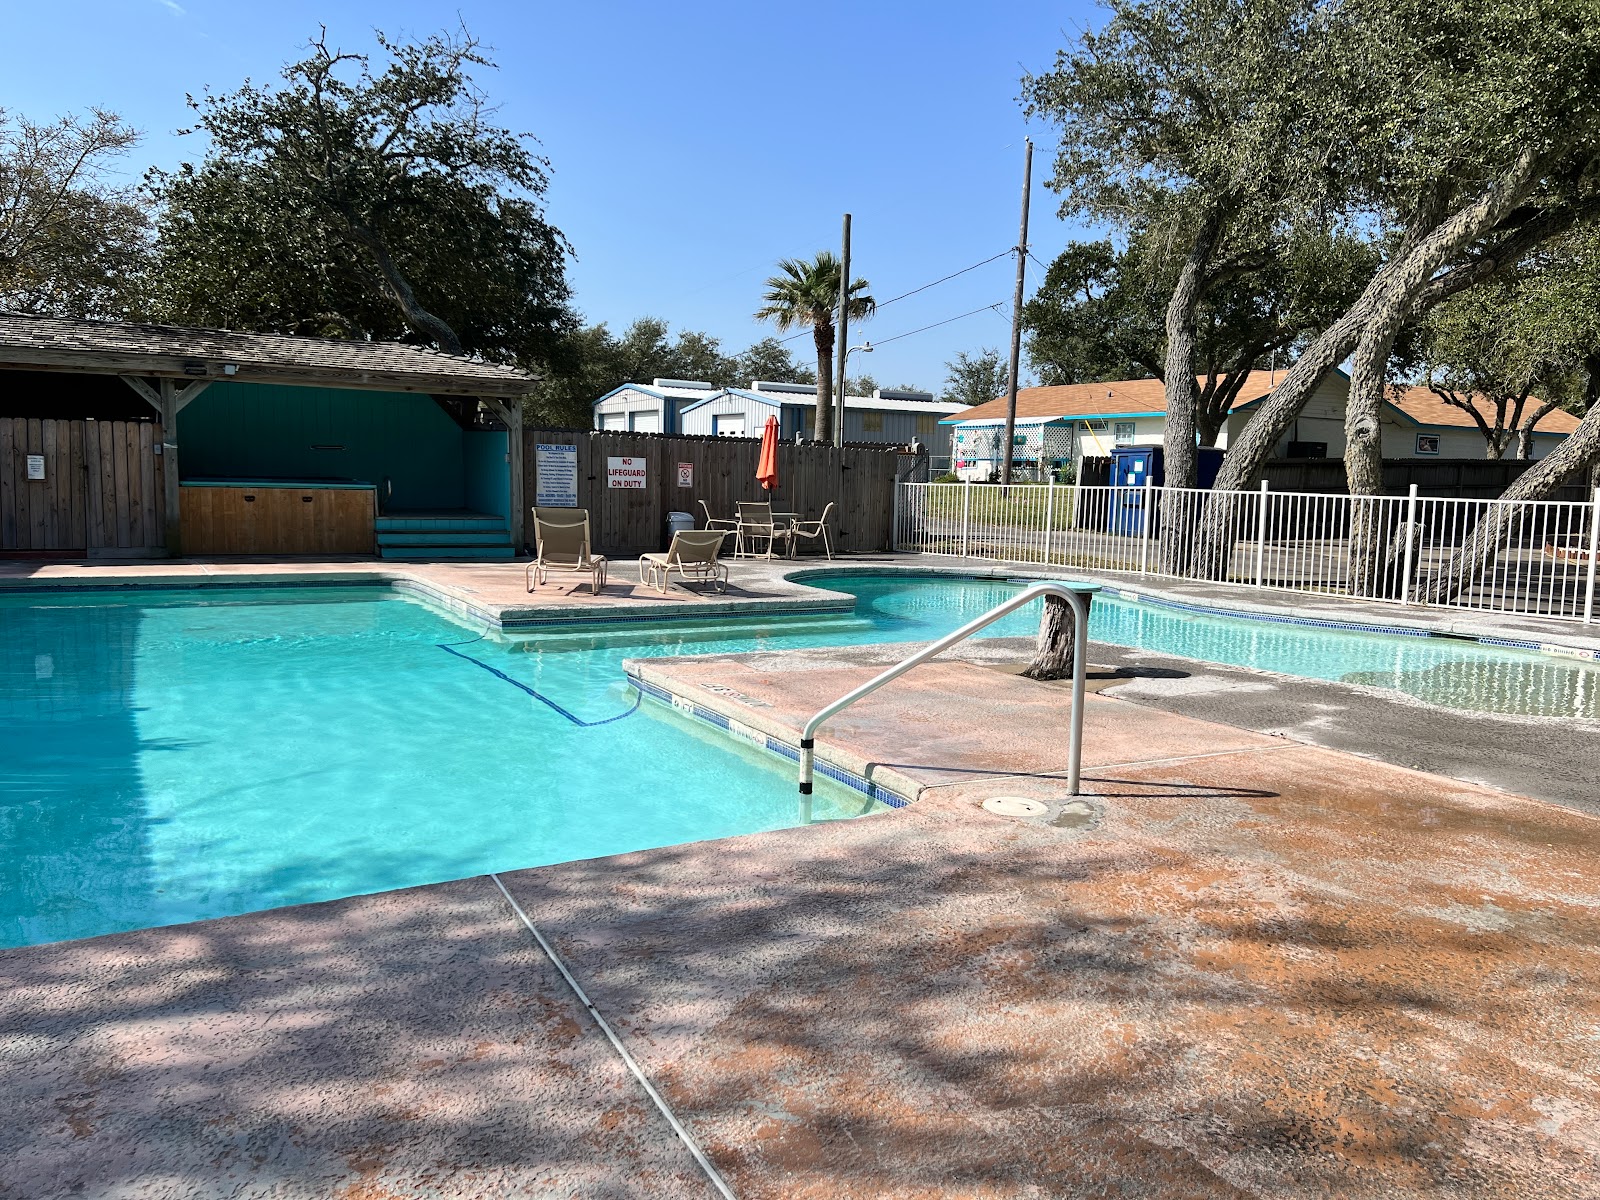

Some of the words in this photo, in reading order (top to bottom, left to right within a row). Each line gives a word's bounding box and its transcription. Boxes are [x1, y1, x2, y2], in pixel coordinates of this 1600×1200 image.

[622, 458, 633, 466] NO
[608, 468, 646, 477] LIFEGUARD
[612, 479, 622, 487] ON
[623, 480, 642, 488] DUTY
